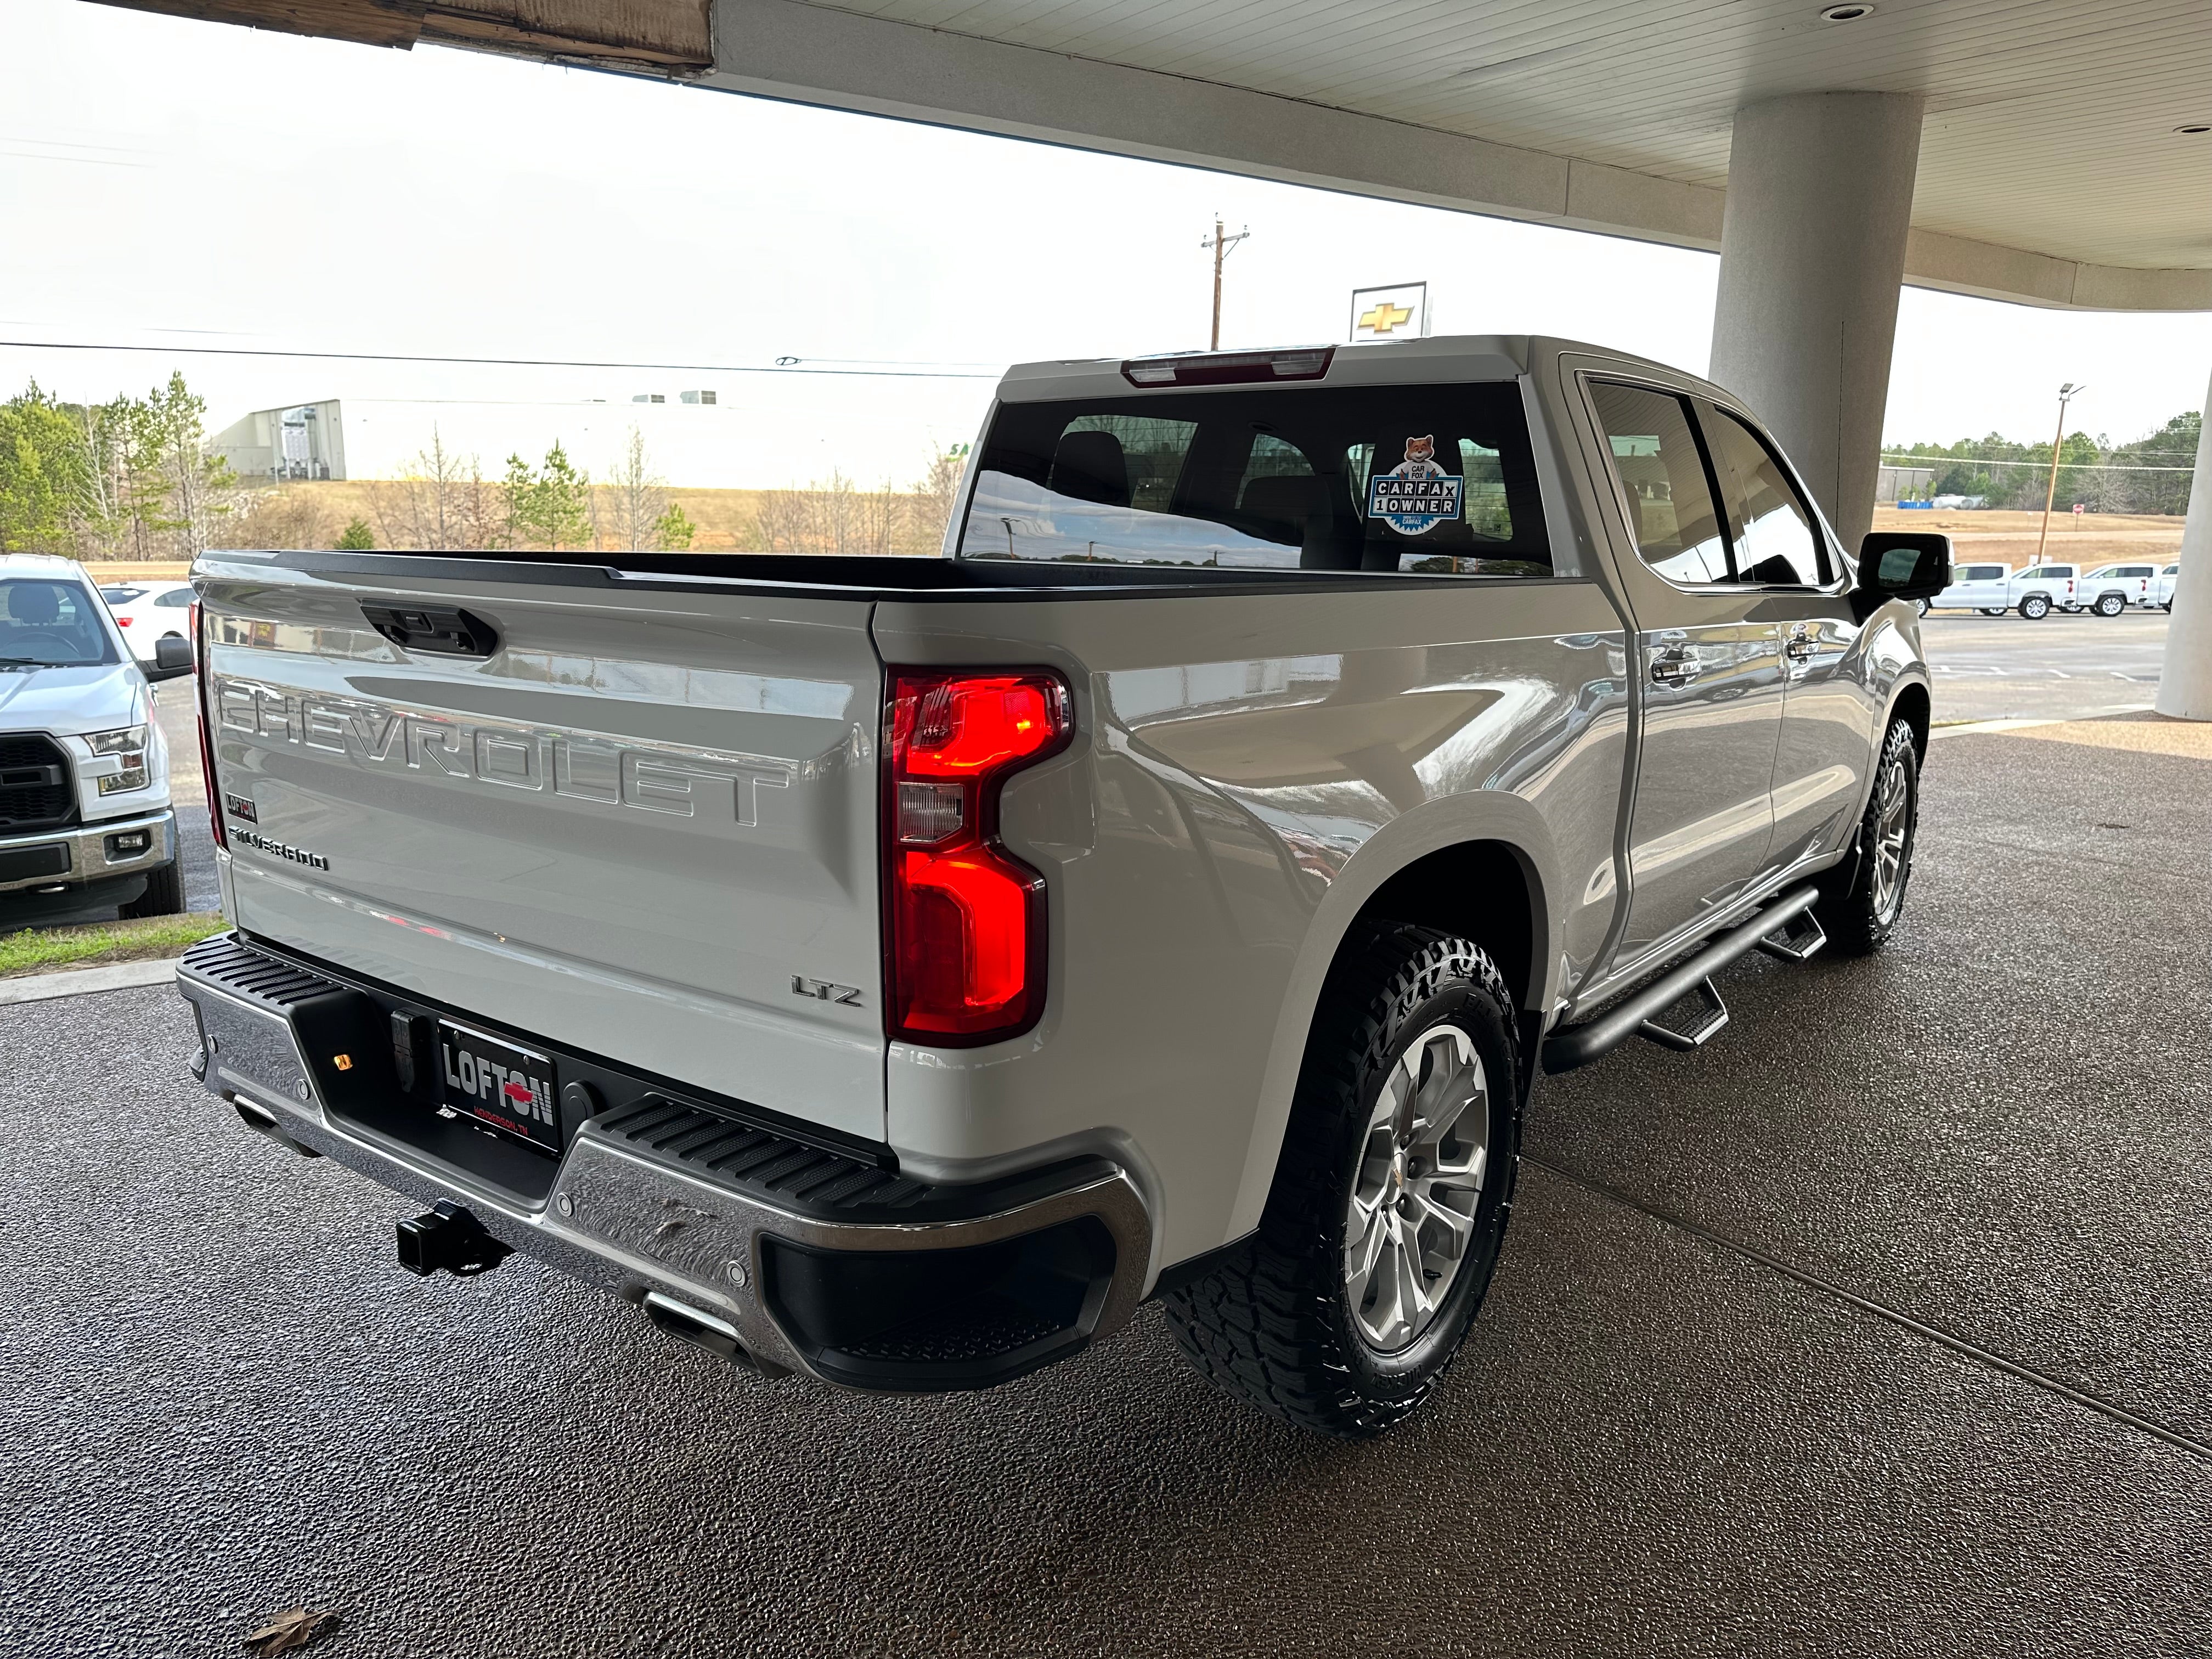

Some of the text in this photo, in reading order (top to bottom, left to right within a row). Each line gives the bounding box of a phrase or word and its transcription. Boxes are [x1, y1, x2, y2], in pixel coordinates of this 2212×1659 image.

[1378, 483, 1455, 496] CARFAX
[1389, 500, 1453, 512] OWNER
[219, 685, 789, 827] CHEVROLET
[227, 795, 255, 817] LOFTON
[228, 825, 329, 871] SILVERADO
[791, 974, 860, 1007] LTZ
[443, 1043, 554, 1126] LOFTON
